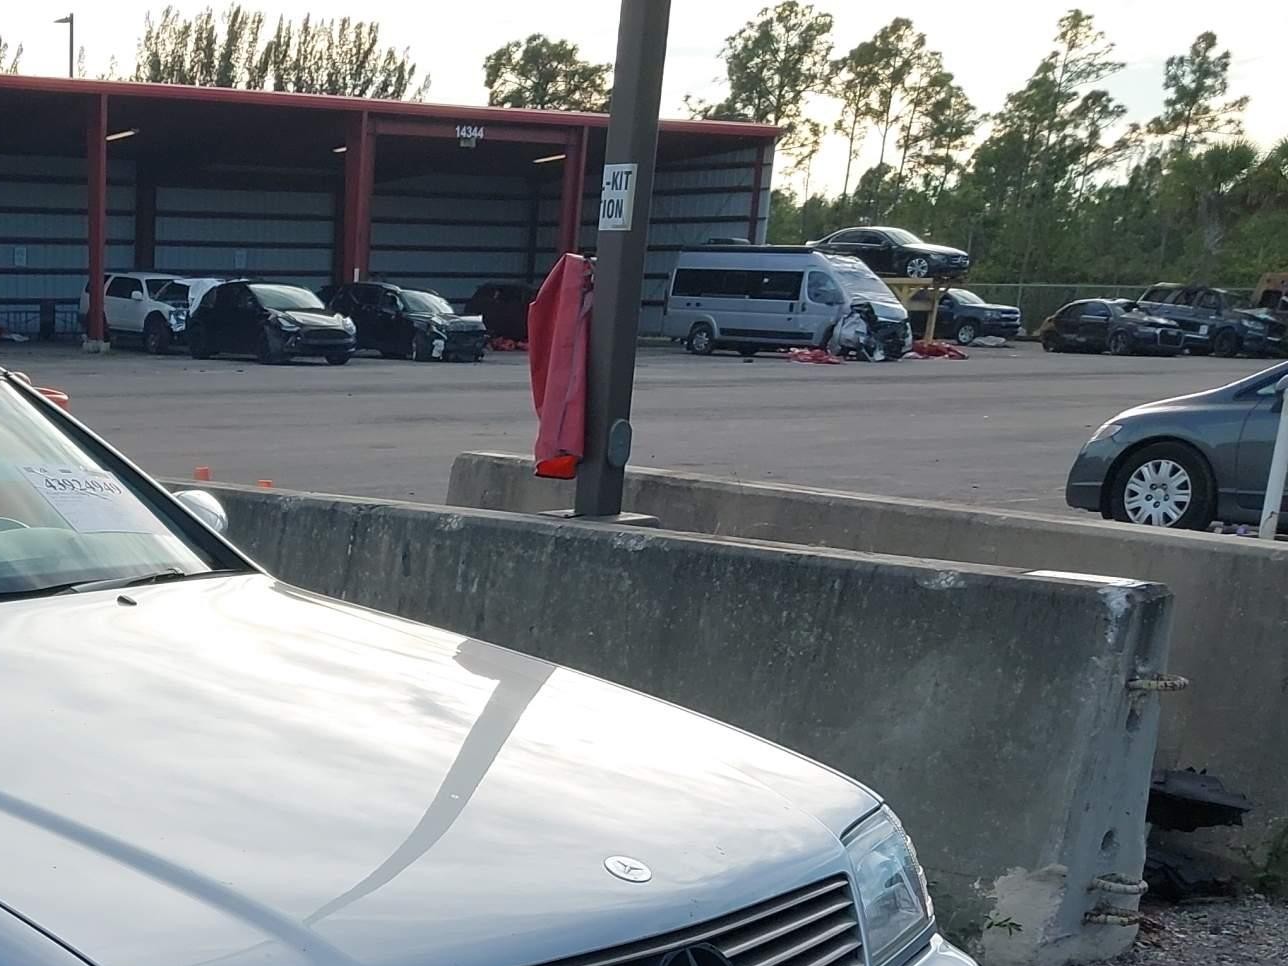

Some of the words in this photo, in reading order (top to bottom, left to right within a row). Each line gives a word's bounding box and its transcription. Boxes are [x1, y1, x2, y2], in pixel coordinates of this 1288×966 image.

[455, 125, 485, 139] 14344
[602, 170, 633, 191] -KIT
[600, 198, 624, 219] ION
[44, 478, 122, 494] 43924949
